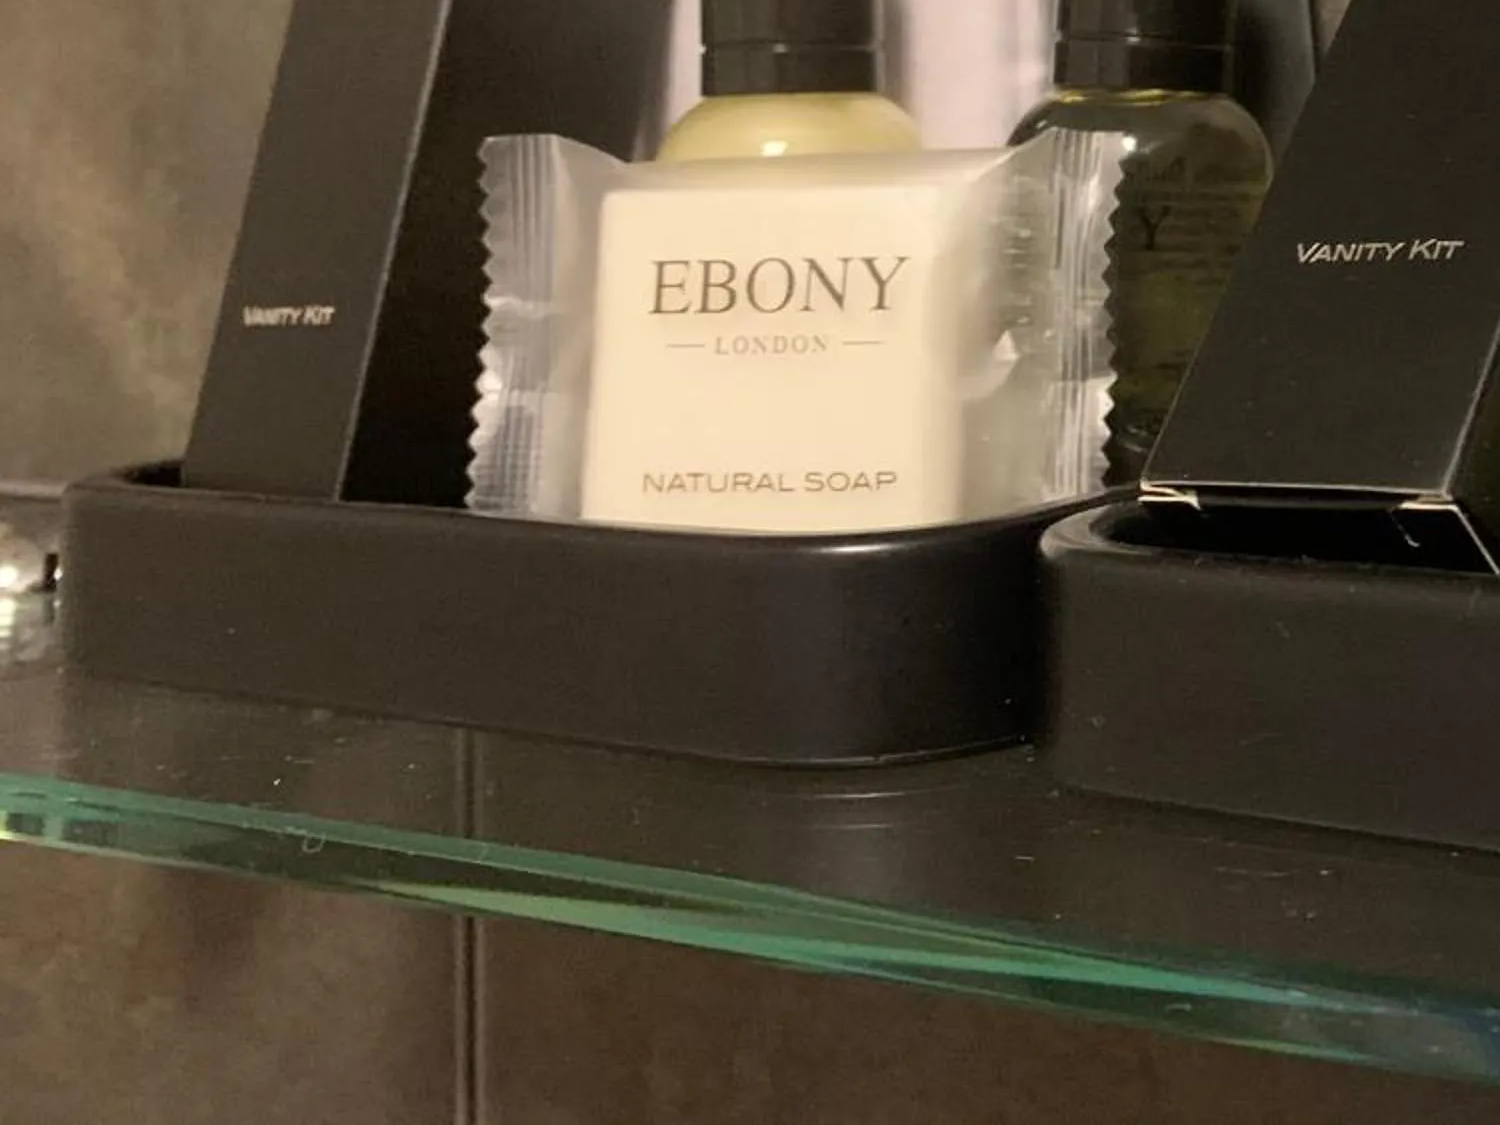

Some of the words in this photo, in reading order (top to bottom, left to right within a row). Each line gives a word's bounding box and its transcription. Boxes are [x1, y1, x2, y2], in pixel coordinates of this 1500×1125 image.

[1297, 242, 1405, 263] VANITY
[1408, 239, 1464, 260] KIT
[648, 256, 911, 315] EBONY
[713, 334, 829, 355] LONDON
[641, 472, 796, 493] NATURAL
[804, 472, 898, 493] SOAP
